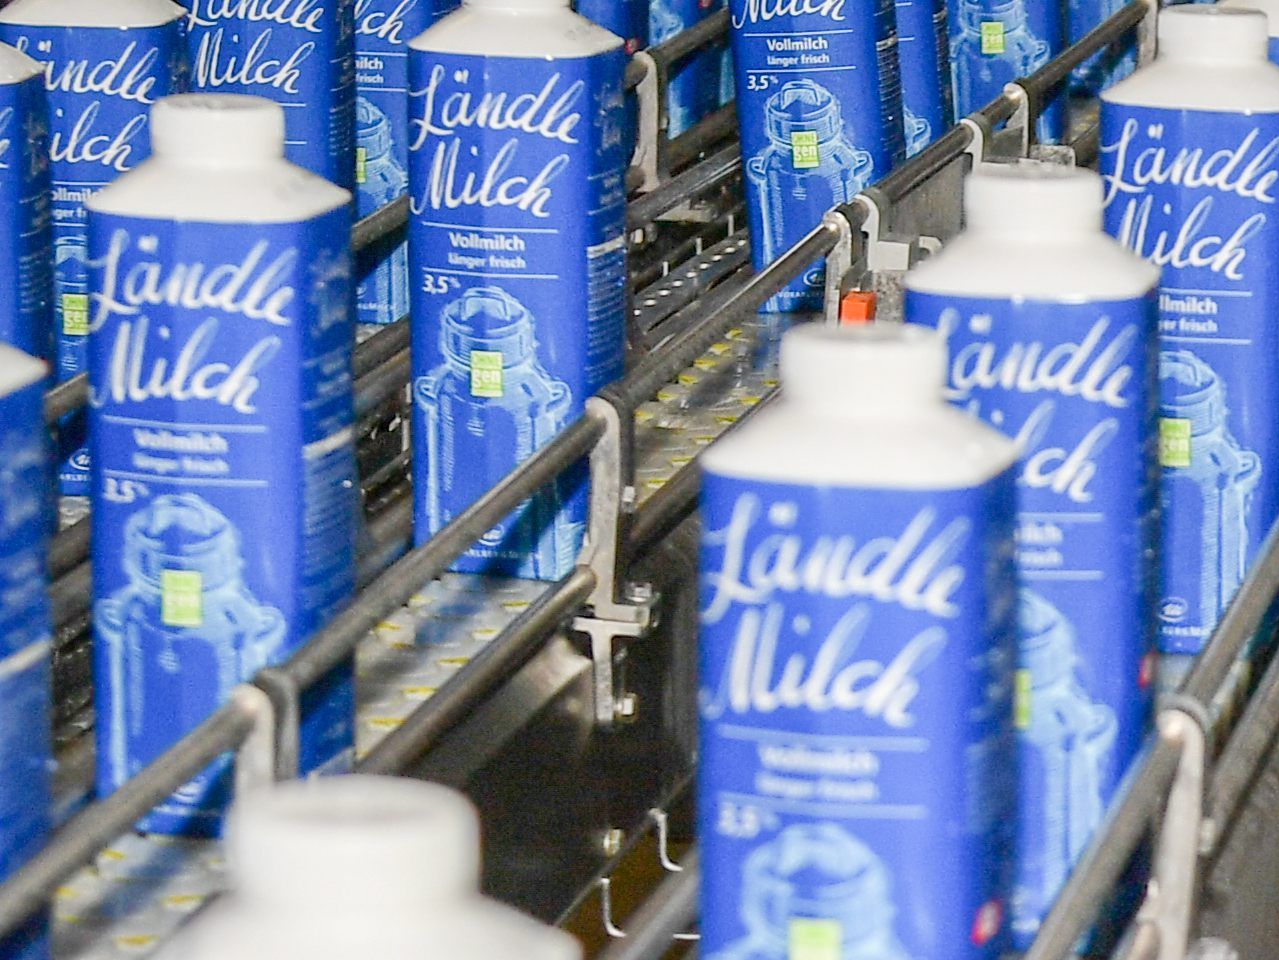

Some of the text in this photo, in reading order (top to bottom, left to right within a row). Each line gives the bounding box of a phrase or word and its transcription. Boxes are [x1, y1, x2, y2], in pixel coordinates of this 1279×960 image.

[766, 36, 829, 51] Vollmilch
[801, 53, 830, 65] frisch
[51, 101, 148, 172] ilch
[409, 64, 585, 151] Ländle
[410, 138, 569, 218] Milch
[86, 228, 298, 332] Ländle
[448, 231, 526, 252] Vollmilch
[1159, 296, 1218, 315] llmilch
[88, 315, 283, 415] Milch
[938, 307, 1139, 408] ändle
[701, 490, 974, 626] Ländle
[701, 601, 949, 729] Milch
